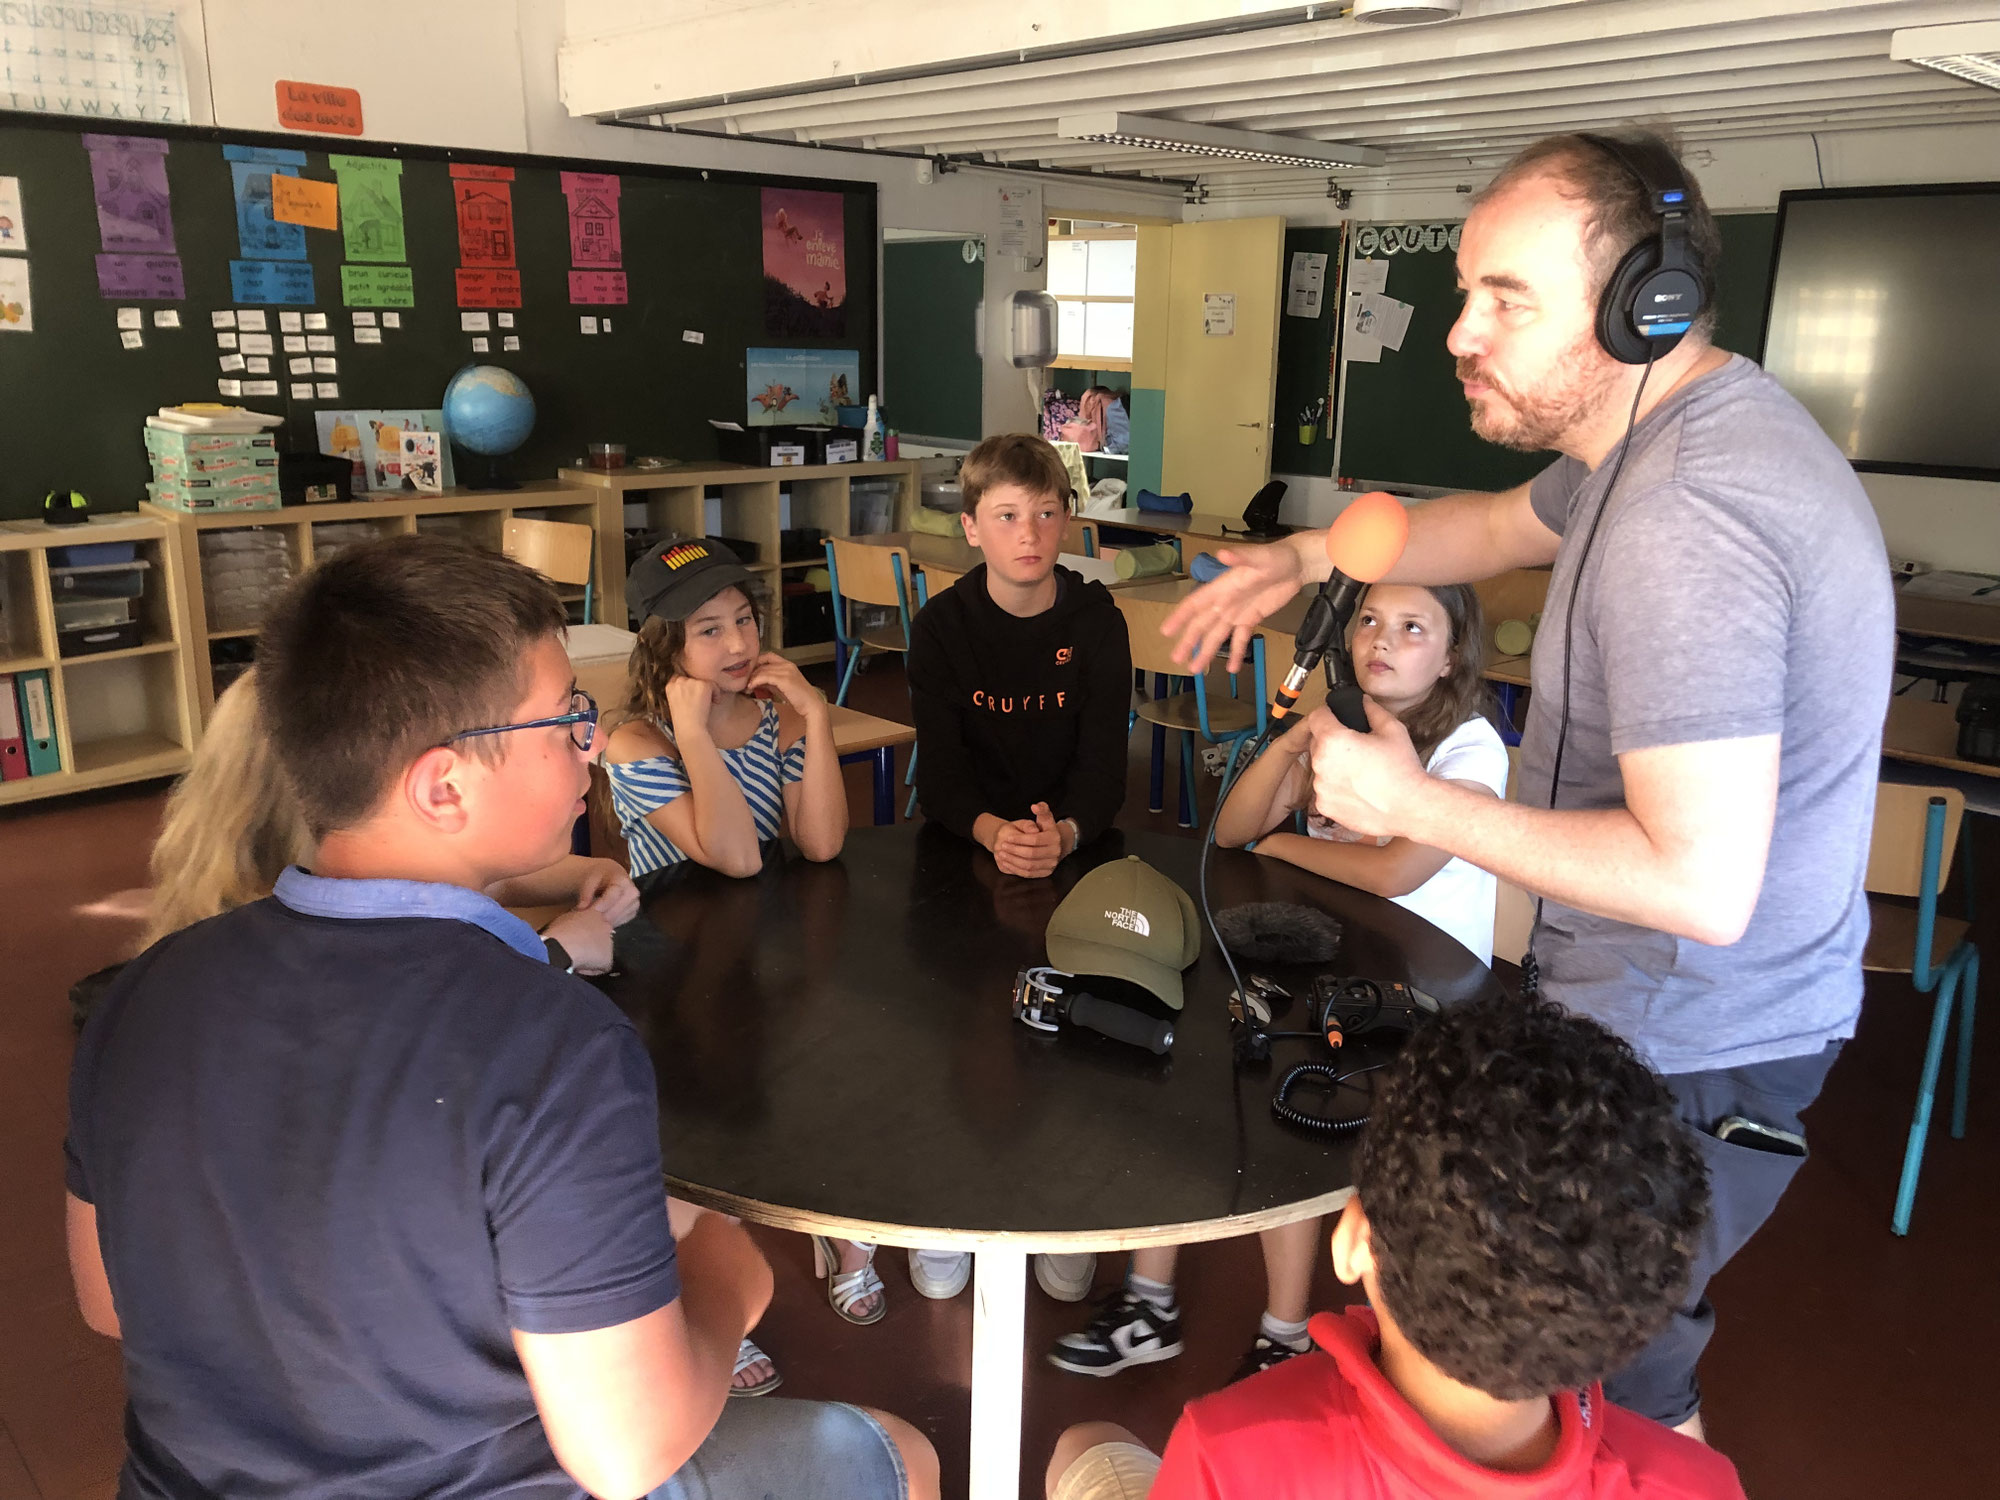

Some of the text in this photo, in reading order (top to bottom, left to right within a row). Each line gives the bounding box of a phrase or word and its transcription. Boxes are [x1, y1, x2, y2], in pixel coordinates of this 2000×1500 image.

[9, 92, 172, 121] T U V W X Y Z
[1359, 227, 1461, 252] CHUT
[806, 252, 841, 270] mamie
[348, 269, 409, 279] brun curieux
[972, 690, 1066, 713] CRUYFF
[1104, 910, 1137, 925] NORTH
[1119, 906, 1138, 918] THE
[1111, 919, 1136, 932] FACE
